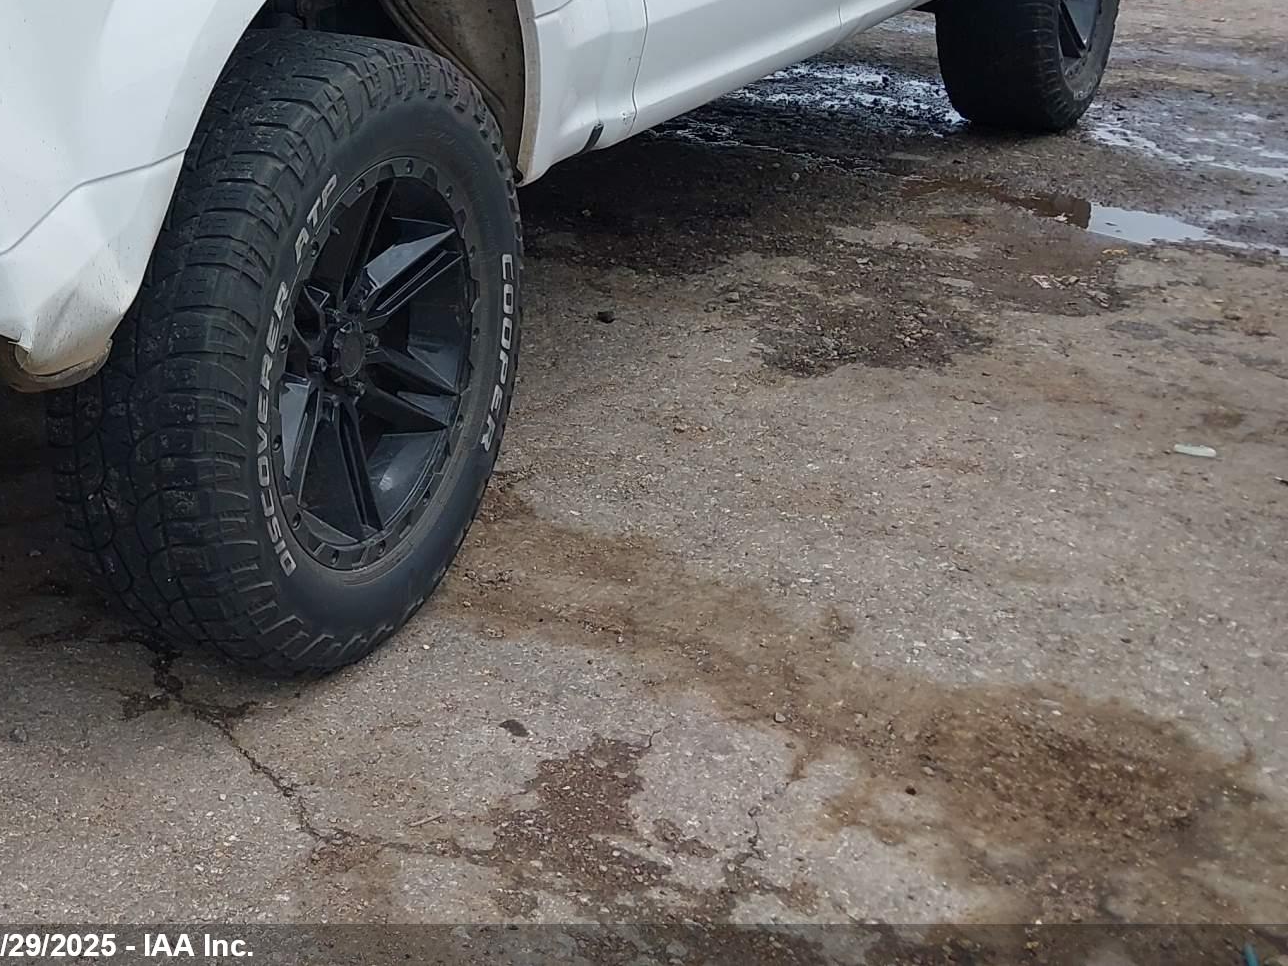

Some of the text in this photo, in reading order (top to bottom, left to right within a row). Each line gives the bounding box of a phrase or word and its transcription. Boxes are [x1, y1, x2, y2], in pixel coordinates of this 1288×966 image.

[256, 173, 338, 577] DISCOVERER ATP
[480, 253, 514, 453] COOPER
